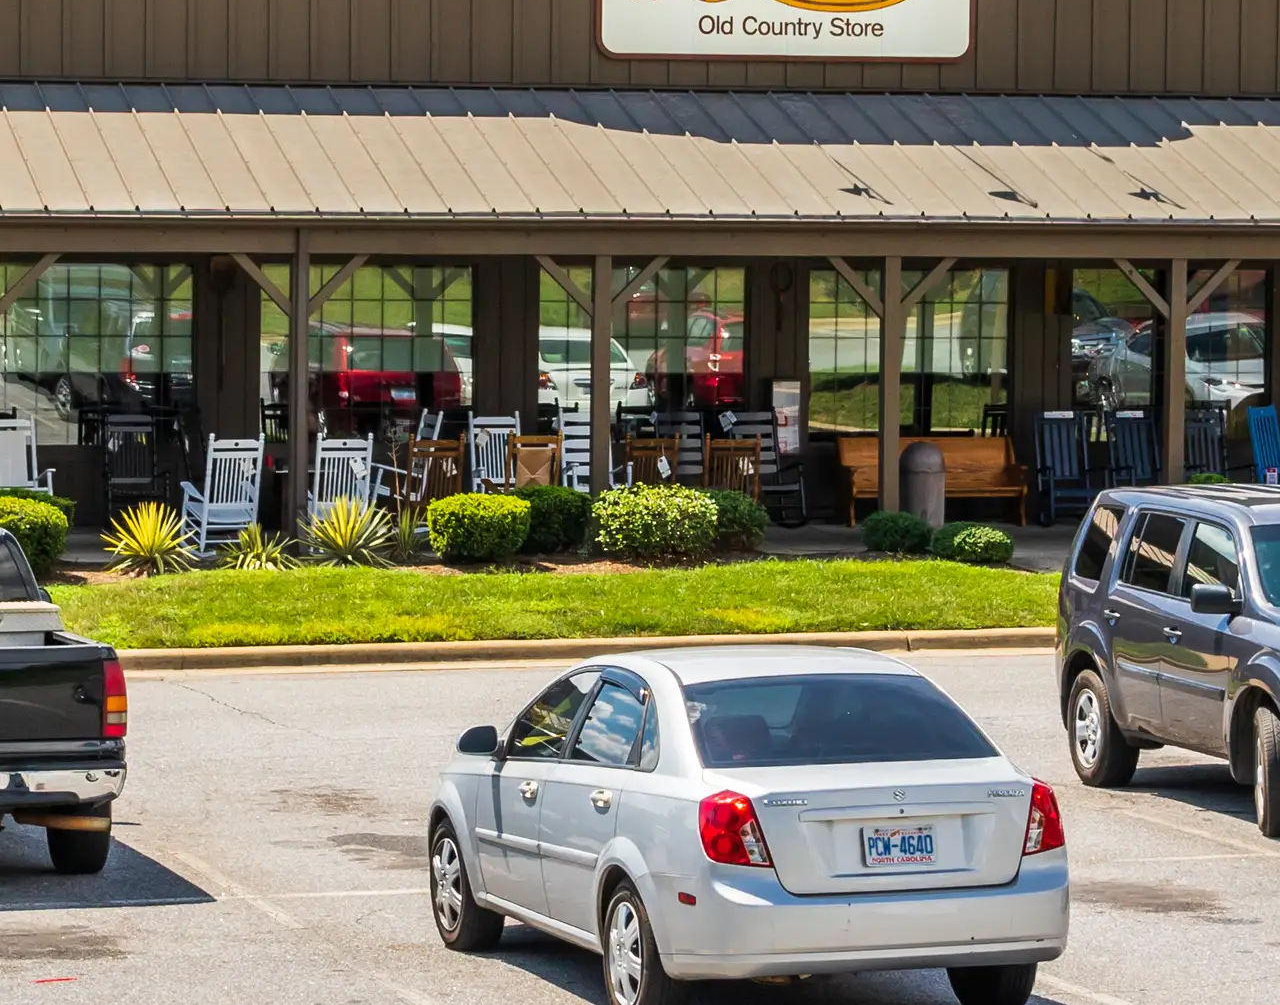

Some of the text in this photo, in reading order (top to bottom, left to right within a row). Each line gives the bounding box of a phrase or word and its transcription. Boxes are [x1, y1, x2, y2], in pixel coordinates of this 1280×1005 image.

[698, 14, 885, 39] Old Country Store
[867, 834, 934, 857] PCW-4640
[872, 855, 933, 864] NORTH CAROLINA
